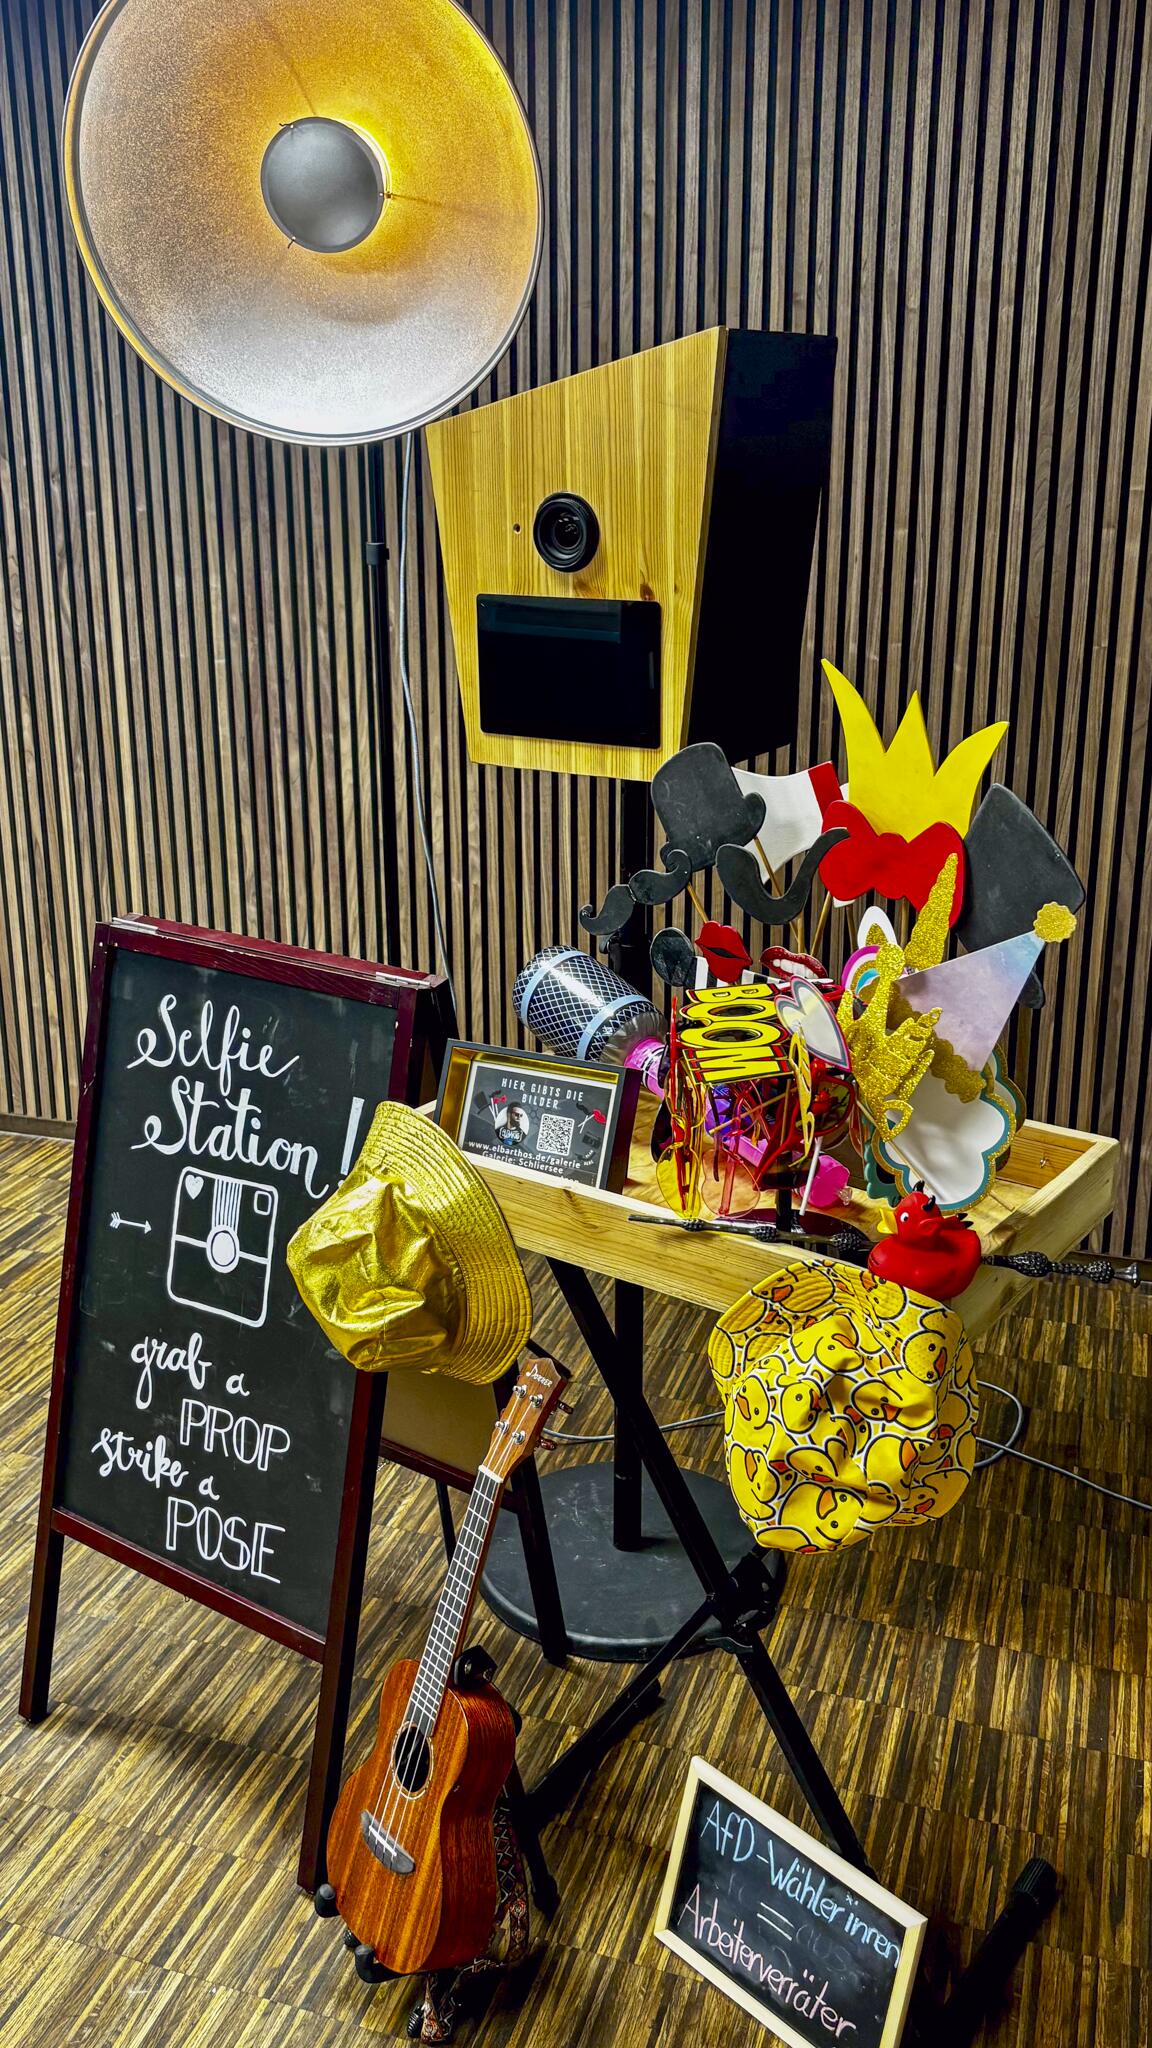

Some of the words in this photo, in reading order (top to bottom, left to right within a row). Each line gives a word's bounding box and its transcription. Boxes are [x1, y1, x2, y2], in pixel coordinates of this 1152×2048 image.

[127, 993, 300, 1097] Selfie
[678, 983, 794, 1084] BOOM
[501, 1077, 526, 1091] HIER
[530, 1083, 561, 1097] GIBTS
[566, 1089, 584, 1101] DIE
[521, 1093, 559, 1109] BILDER
[518, 1158, 564, 1174] Schliersee
[130, 1332, 213, 1410] grab
[225, 1373, 250, 1397] a
[179, 1398, 291, 1472] PROP
[198, 1475, 220, 1501] a
[165, 1496, 286, 1584] POSE
[677, 1883, 857, 2038] Arbeiterverräter
